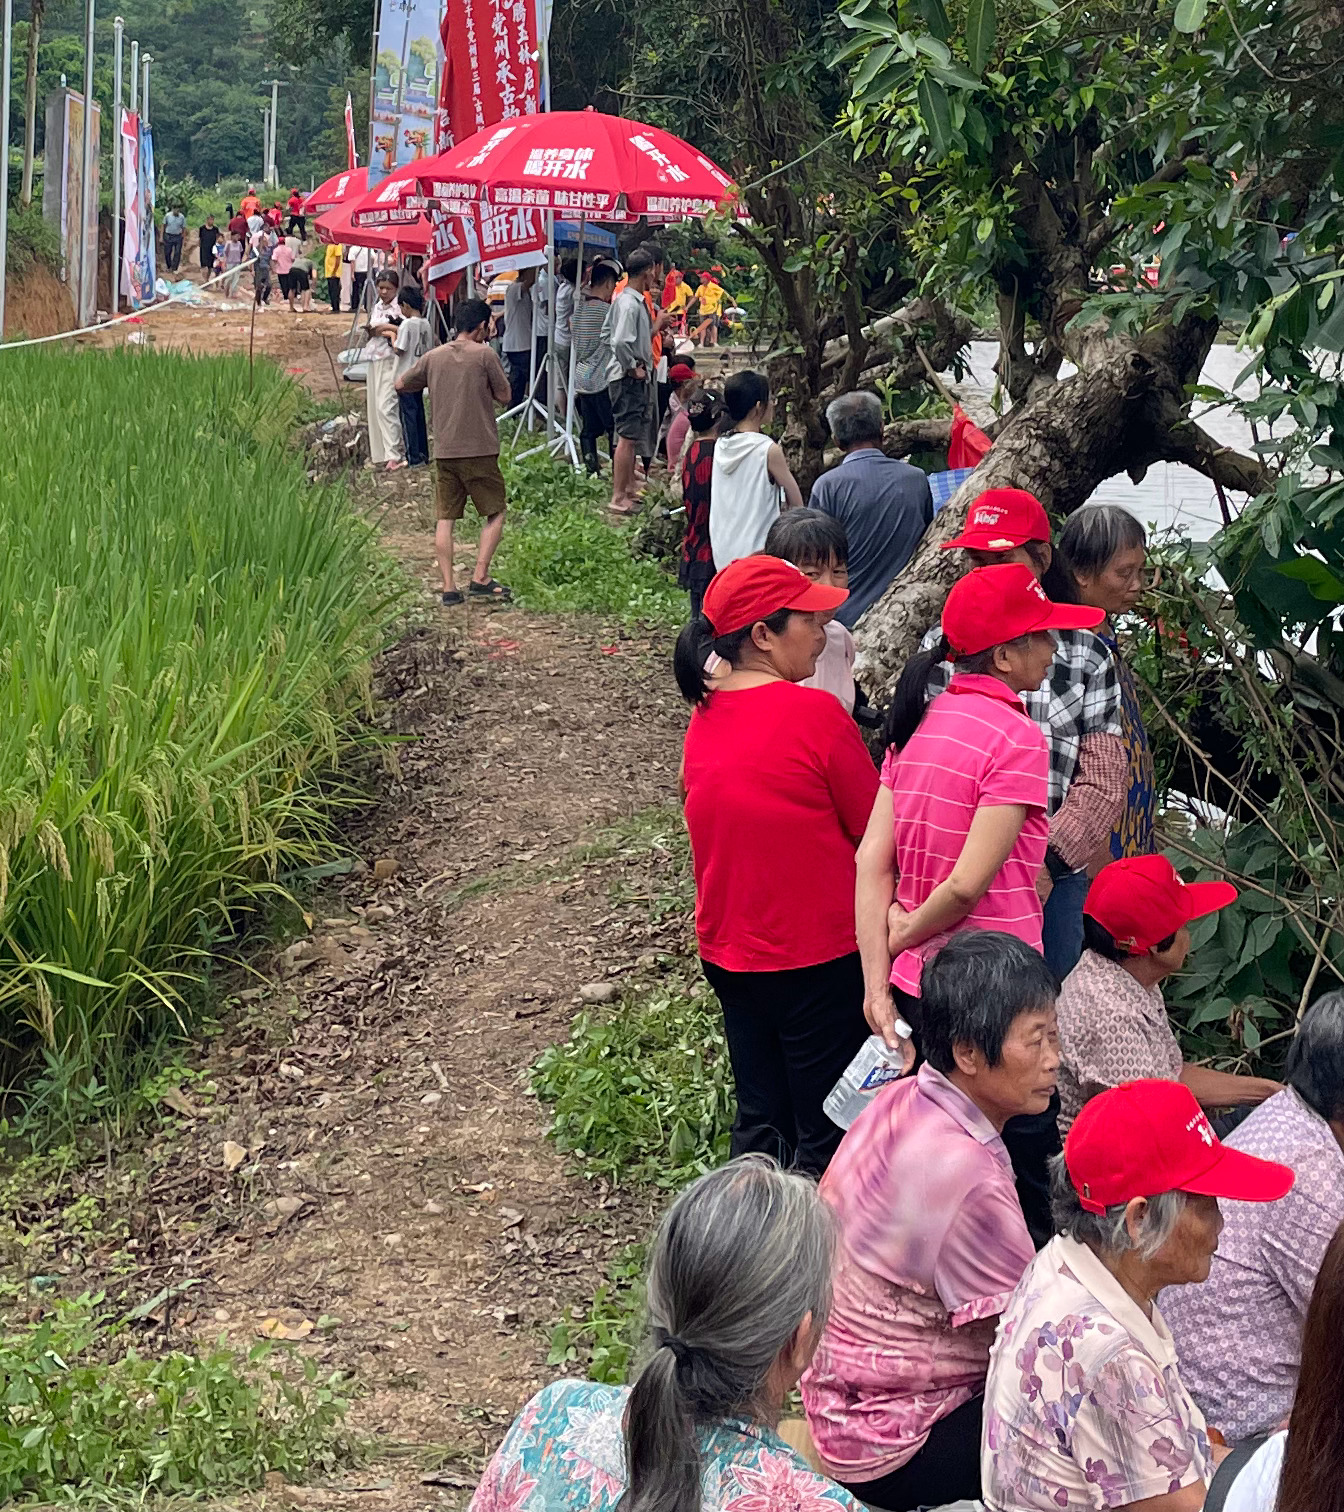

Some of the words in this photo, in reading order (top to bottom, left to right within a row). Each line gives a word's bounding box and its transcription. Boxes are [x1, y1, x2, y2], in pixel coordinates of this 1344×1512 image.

[523, 159, 590, 180] 喝开水
[494, 188, 550, 205] 高温杀菌
[554, 190, 610, 209] 味甘性平
